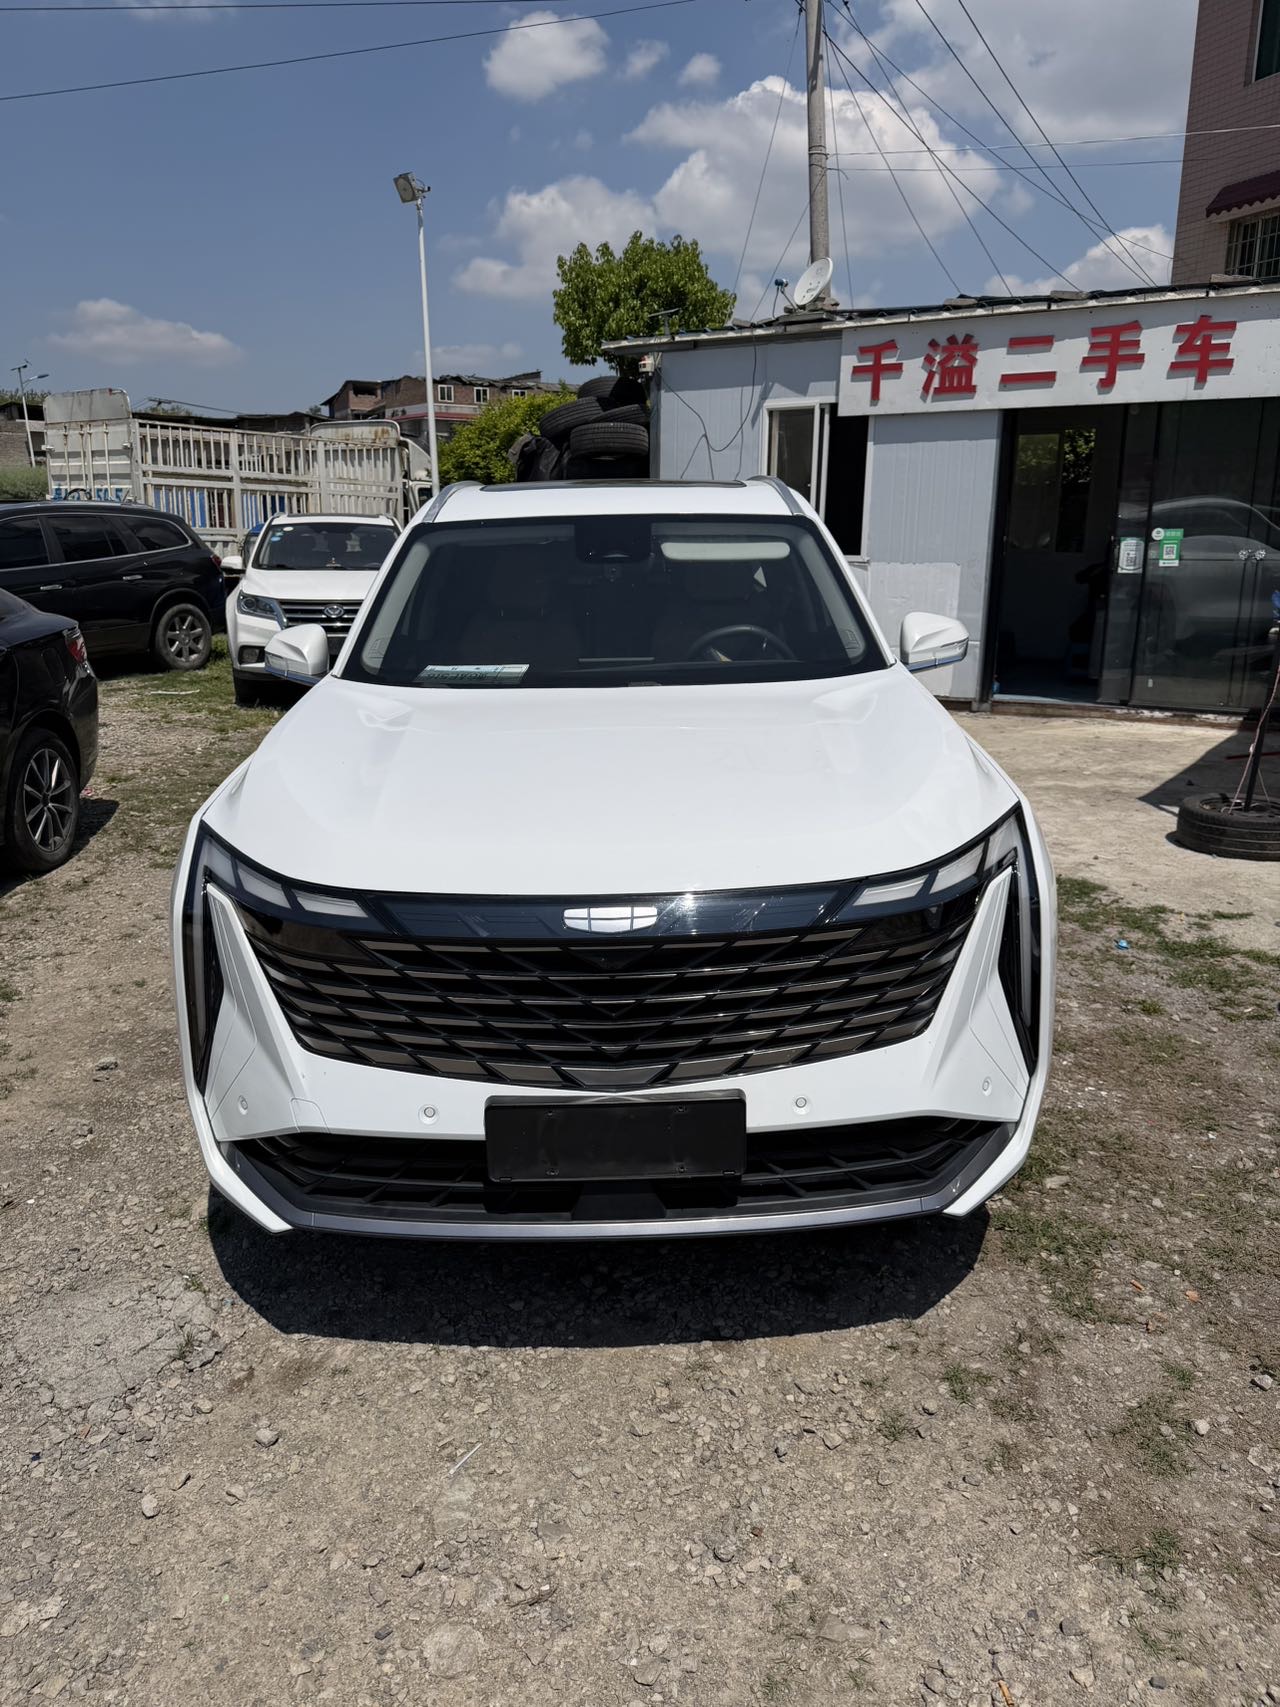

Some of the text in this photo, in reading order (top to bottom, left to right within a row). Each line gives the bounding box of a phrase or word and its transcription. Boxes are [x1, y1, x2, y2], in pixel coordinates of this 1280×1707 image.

[852, 314, 1237, 402] 千溢二手车
